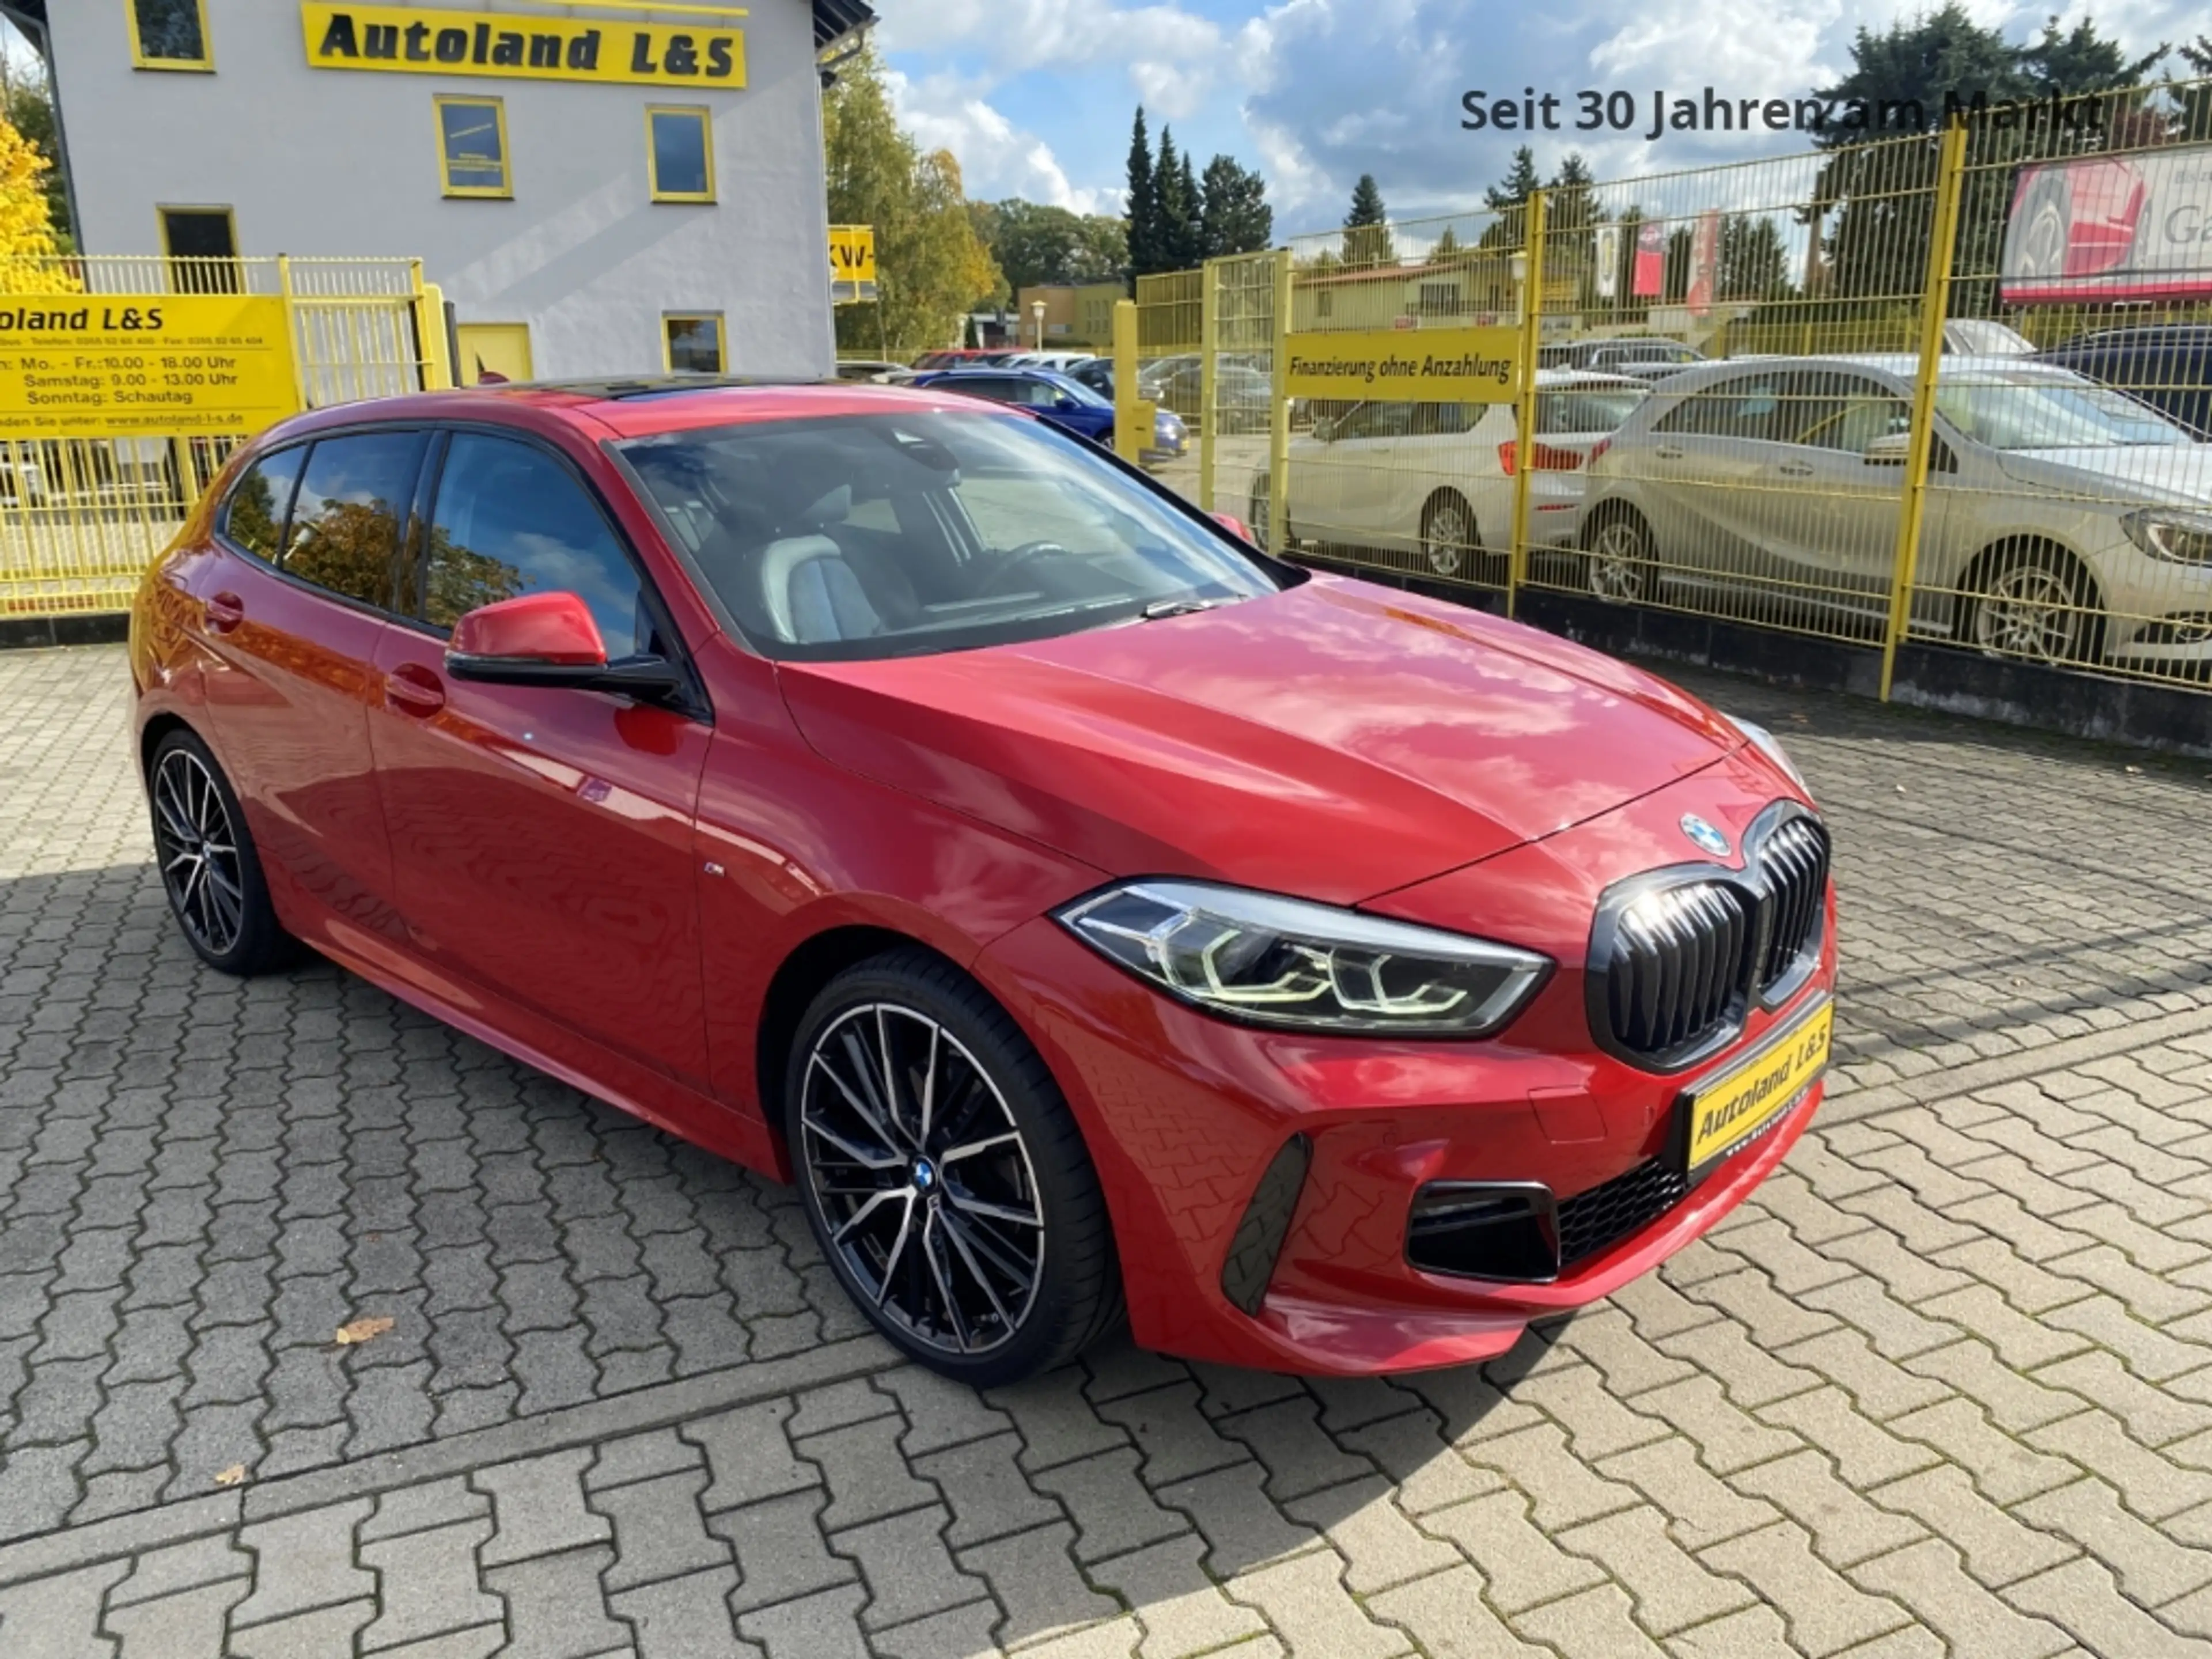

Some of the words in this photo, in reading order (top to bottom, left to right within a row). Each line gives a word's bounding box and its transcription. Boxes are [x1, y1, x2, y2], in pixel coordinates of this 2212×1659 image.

[319, 13, 601, 71] Autoland
[630, 32, 733, 78] L&S
[102, 308, 164, 331] L&S
[21, 357, 55, 370] Mo.
[160, 355, 202, 370] 18.00
[207, 356, 237, 369] Uhr
[1290, 355, 1376, 384] Finanzierung
[1379, 354, 1418, 377] ohne
[1421, 351, 1512, 385] Anzahlung
[23, 373, 106, 389] Samstag:
[111, 373, 147, 386] 9.00
[164, 373, 205, 386] 13.00
[210, 373, 238, 385] Uhr
[27, 391, 109, 407] Sonntag:
[113, 389, 194, 404] Schautag
[1696, 1053, 1792, 1146] Autoland
[1795, 1023, 1827, 1072] L&S
